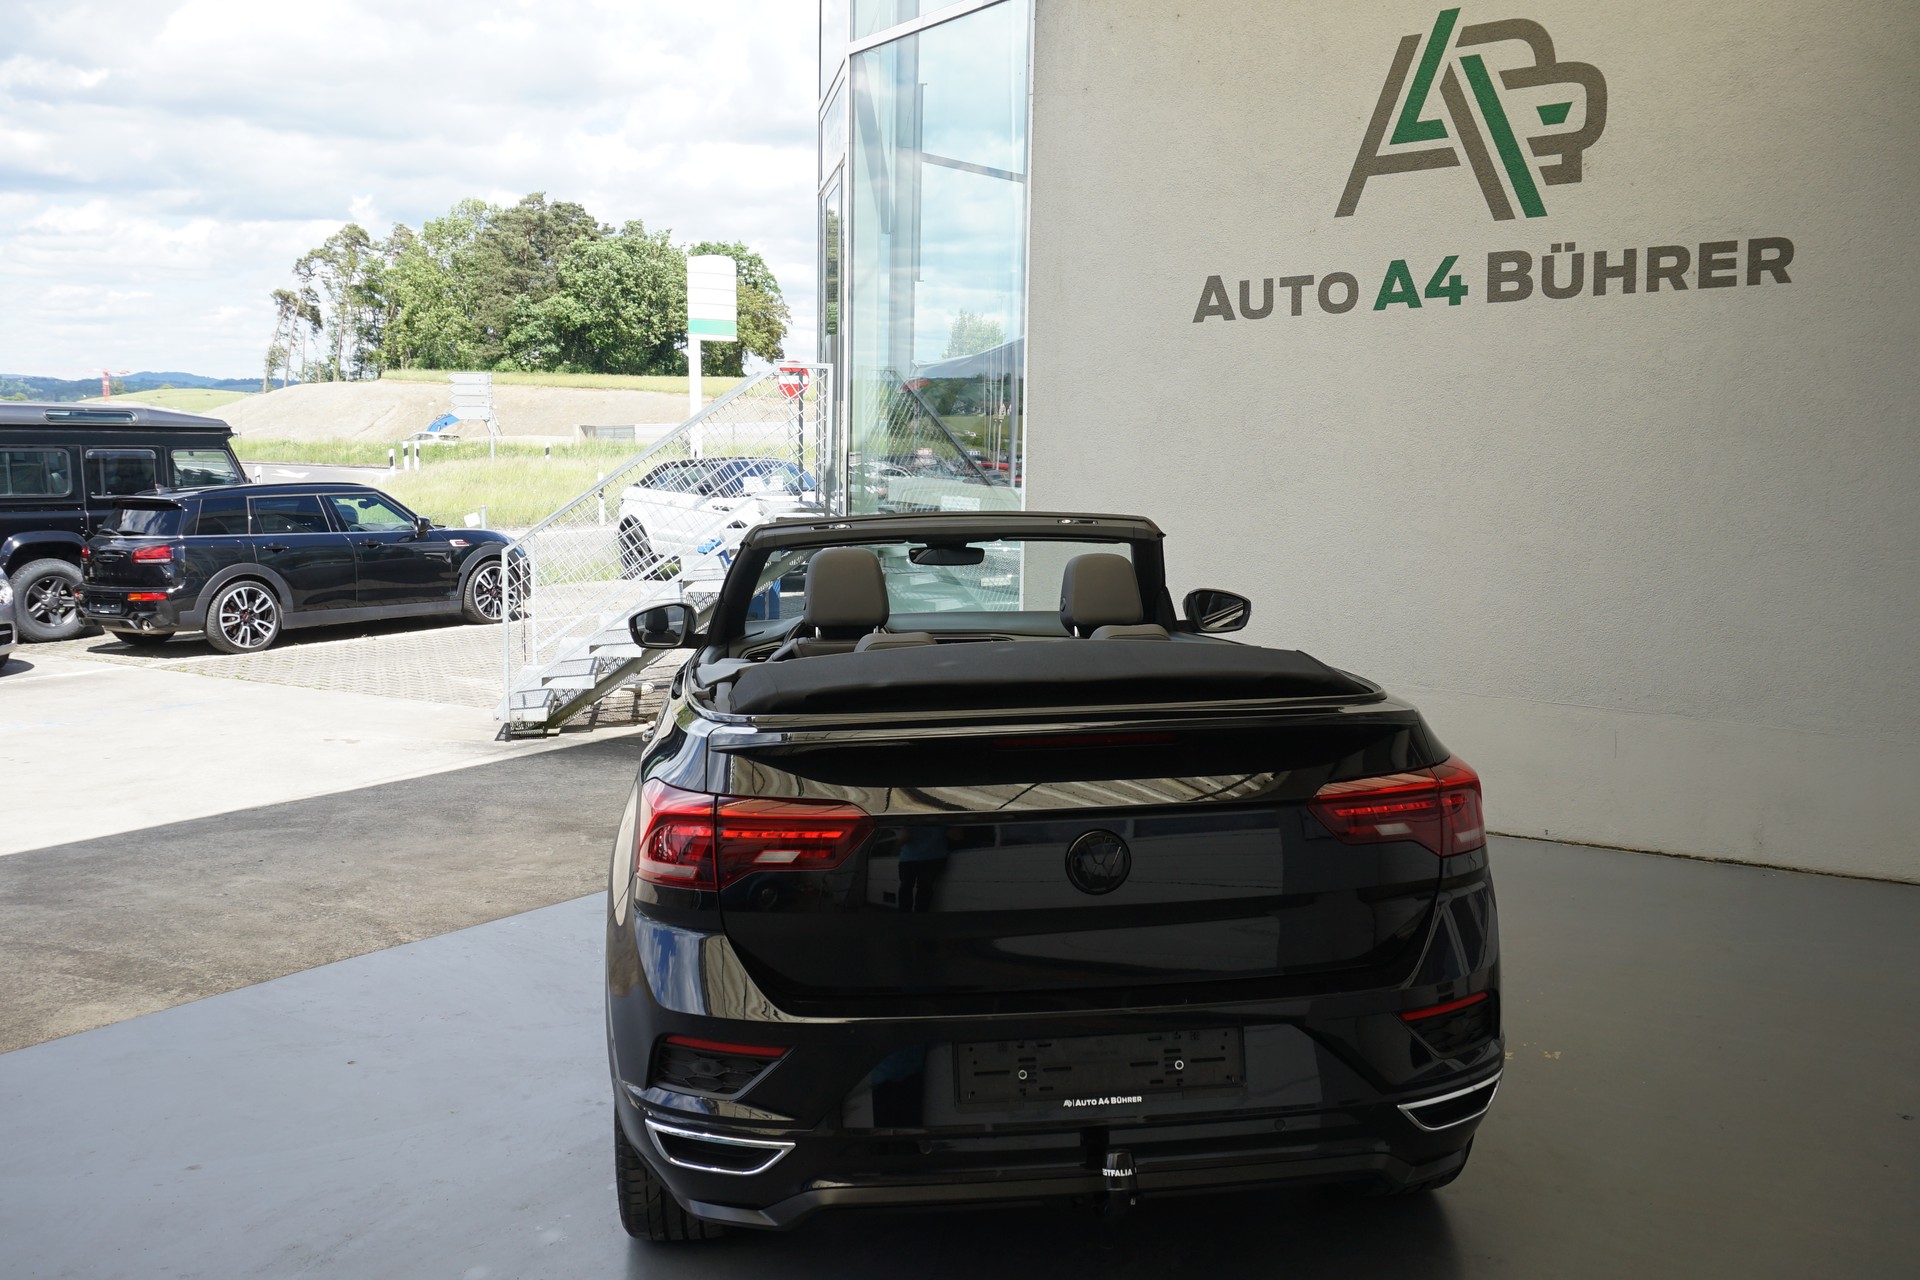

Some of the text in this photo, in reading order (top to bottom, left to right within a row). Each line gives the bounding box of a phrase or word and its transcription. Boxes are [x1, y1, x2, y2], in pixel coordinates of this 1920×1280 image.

[1192, 236, 1795, 324] AUTO A4 BÜHRER
[1098, 1097, 1109, 1105] A4
